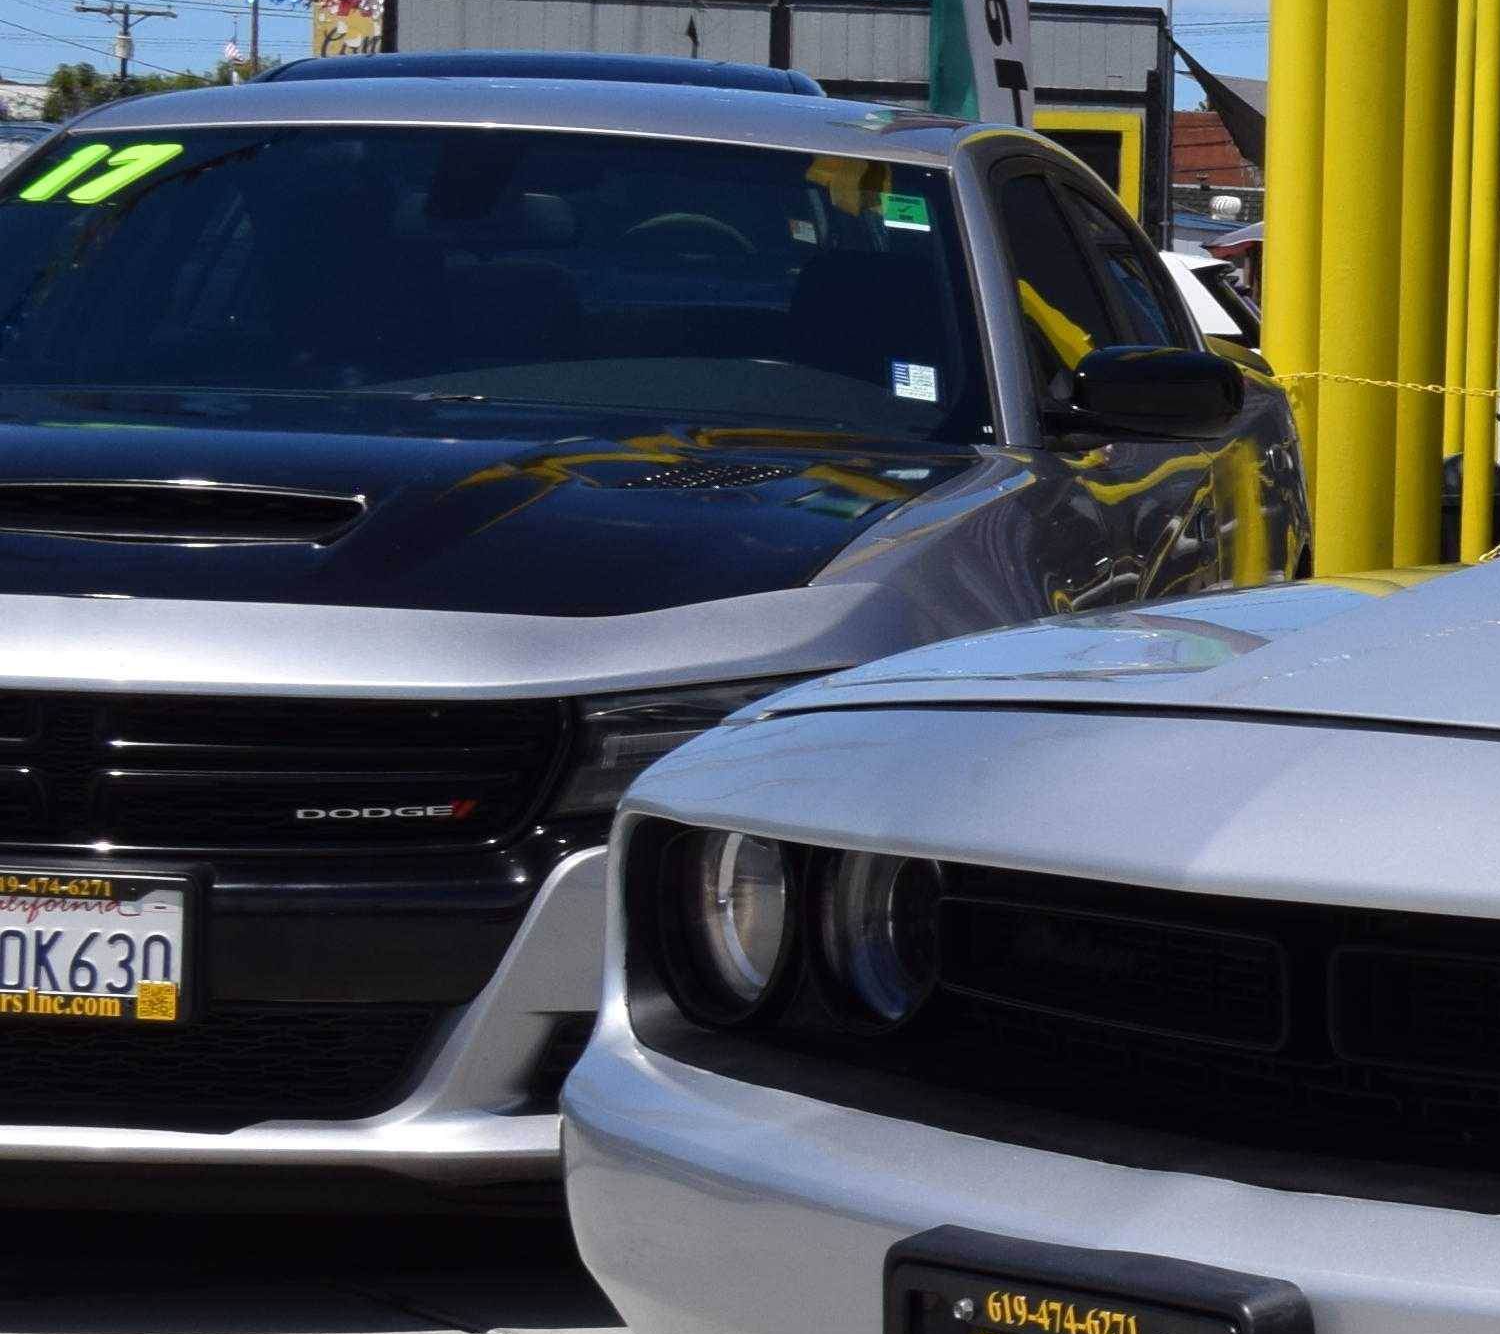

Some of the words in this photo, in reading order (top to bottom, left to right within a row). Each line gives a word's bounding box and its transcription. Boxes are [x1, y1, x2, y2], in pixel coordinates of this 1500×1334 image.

[19, 143, 184, 205] 17
[296, 805, 454, 819] DODGE
[0, 875, 112, 896] 19-474-6271
[0, 928, 173, 995] OK630
[0, 993, 22, 1013] rs
[27, 986, 121, 1016] Inc.com
